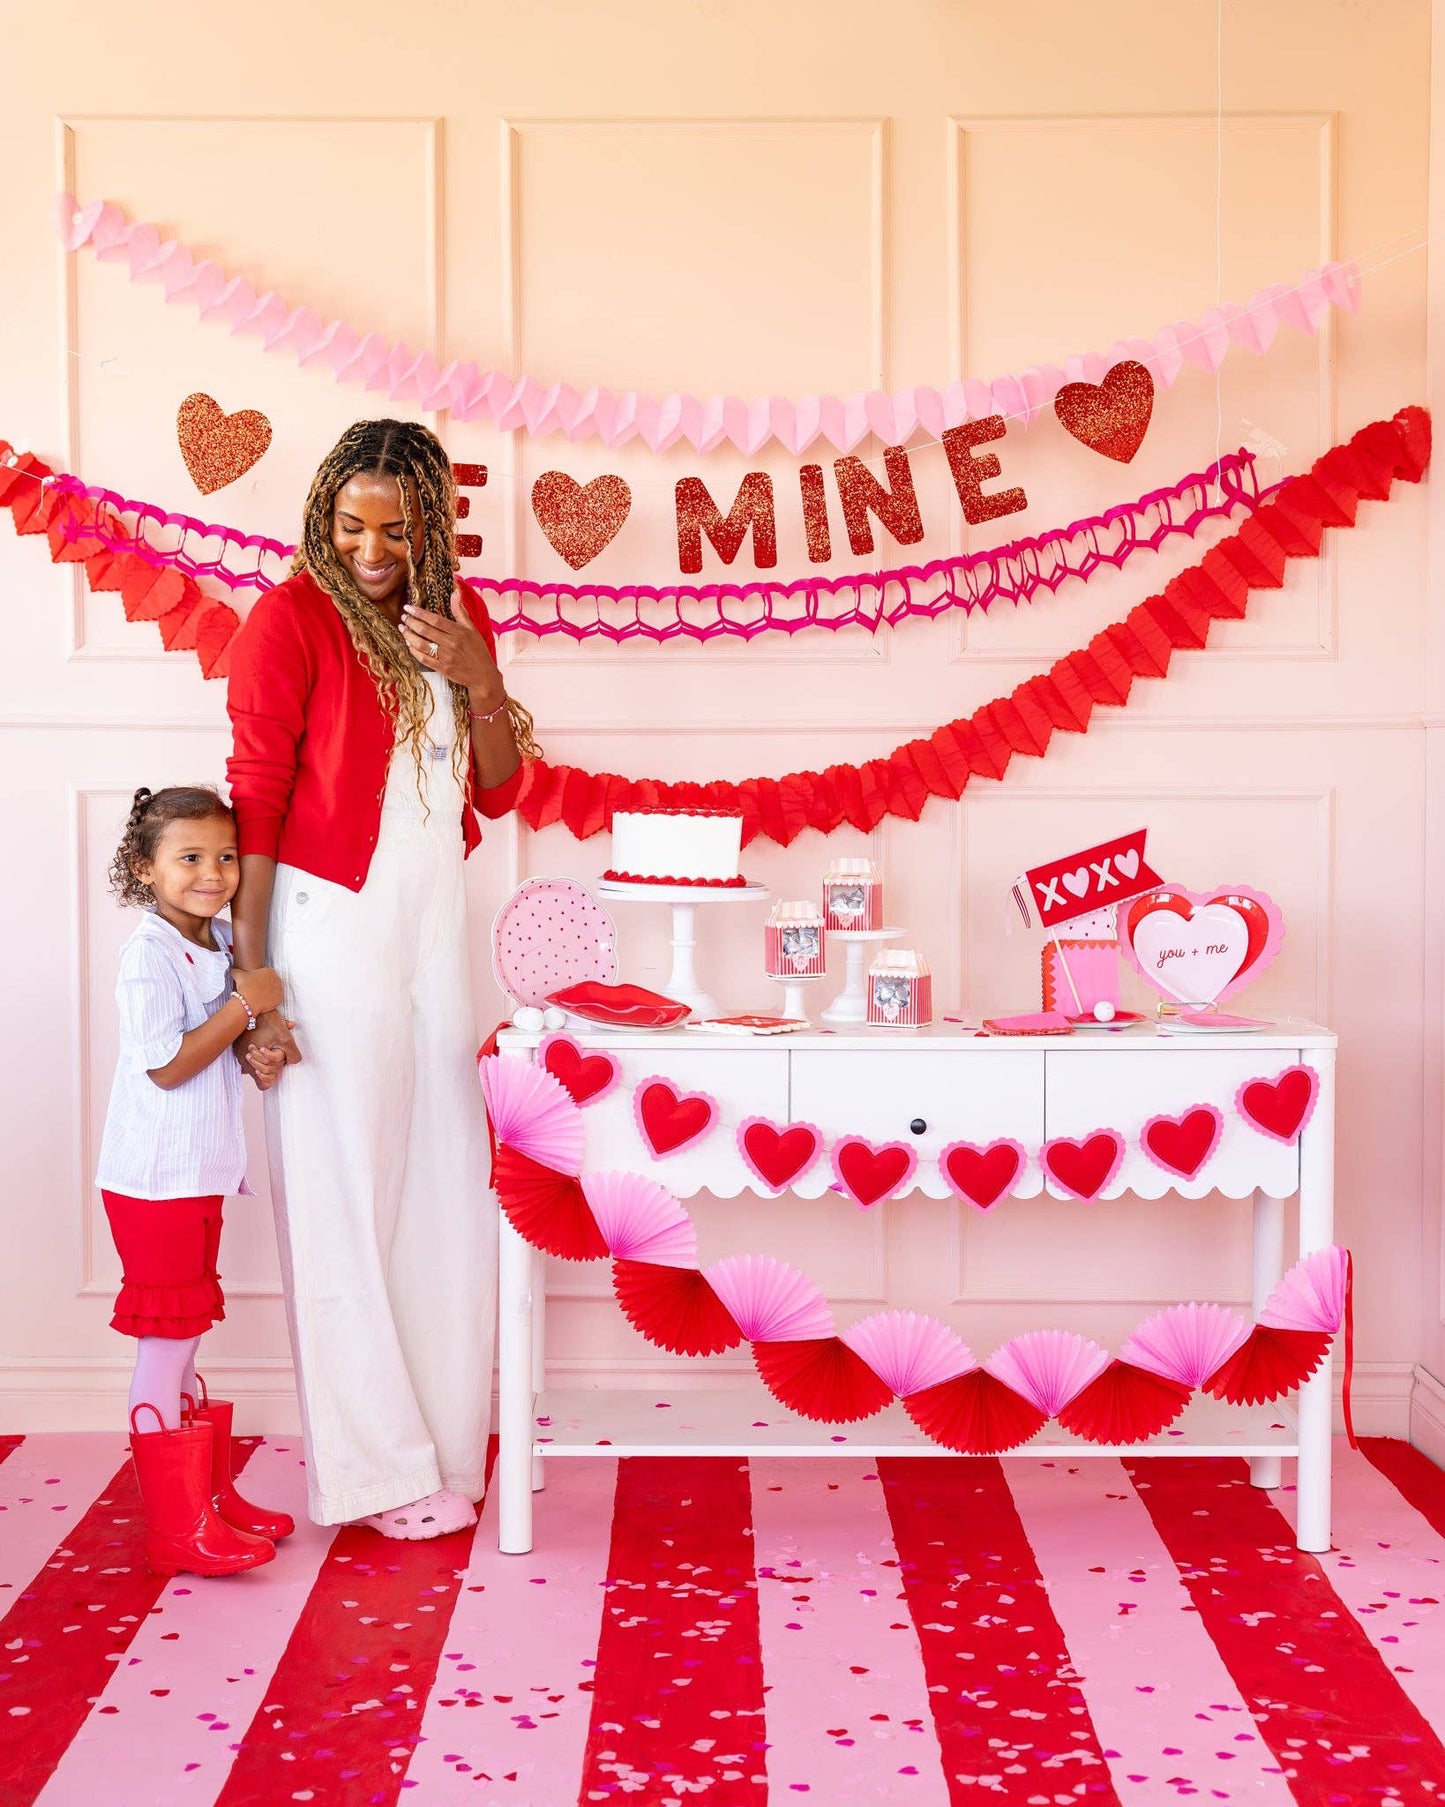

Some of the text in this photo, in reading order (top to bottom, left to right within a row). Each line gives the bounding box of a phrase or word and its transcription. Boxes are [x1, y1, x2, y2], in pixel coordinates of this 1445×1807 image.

[675, 414, 1028, 573] MINE
[1156, 947, 1186, 968] you
[1206, 943, 1229, 956] me
